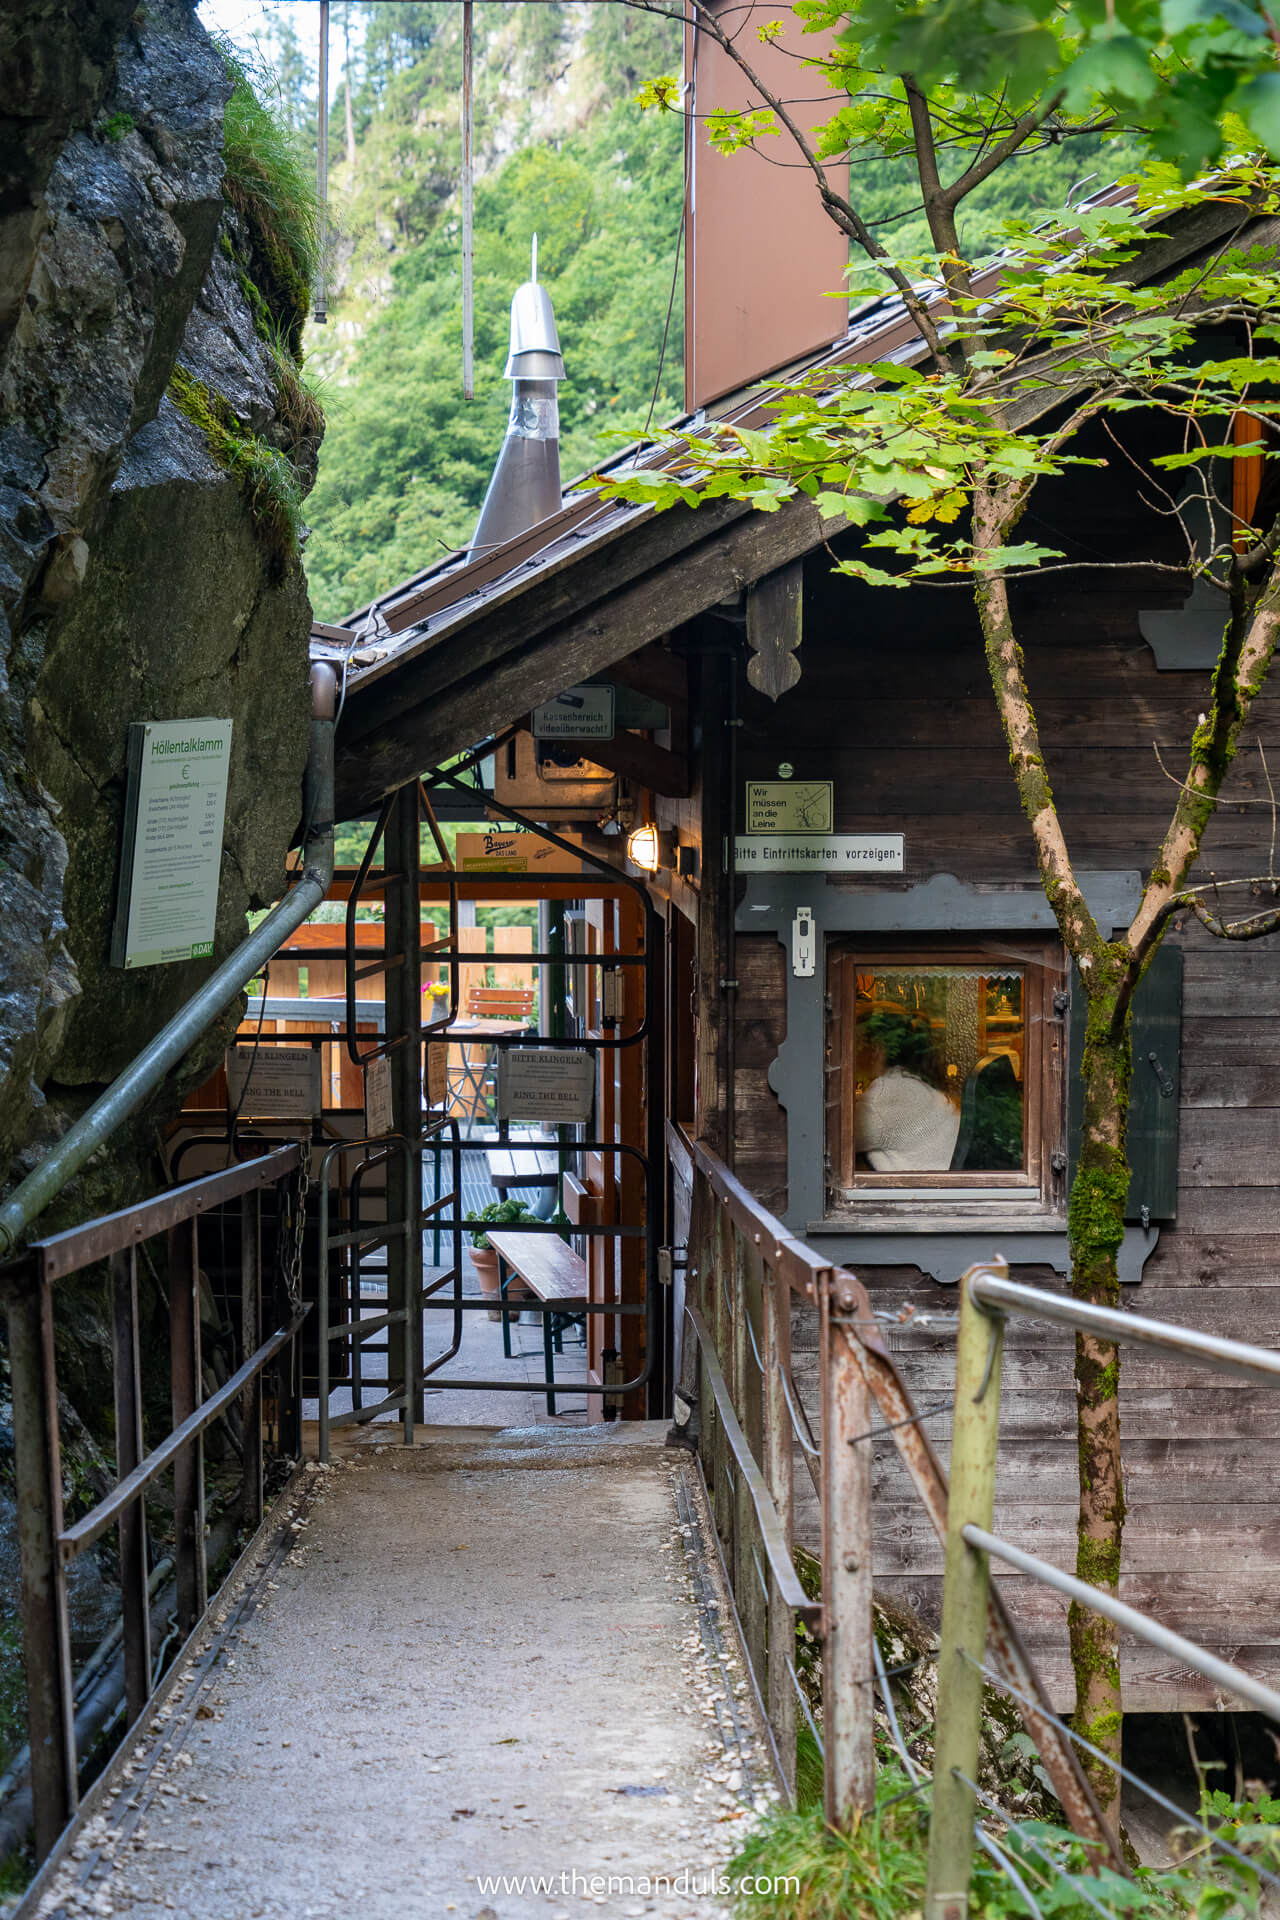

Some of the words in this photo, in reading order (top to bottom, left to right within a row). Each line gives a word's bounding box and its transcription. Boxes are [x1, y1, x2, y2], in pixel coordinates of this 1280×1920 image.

[543, 711, 604, 721] Kassenbereich
[151, 737, 223, 756] Höllentalklamm
[752, 788, 768, 796] Wir
[752, 799, 787, 807] müssen
[752, 820, 776, 828] Leine
[763, 847, 838, 859] Eintrittskarten
[846, 848, 895, 861] vorzeigen
